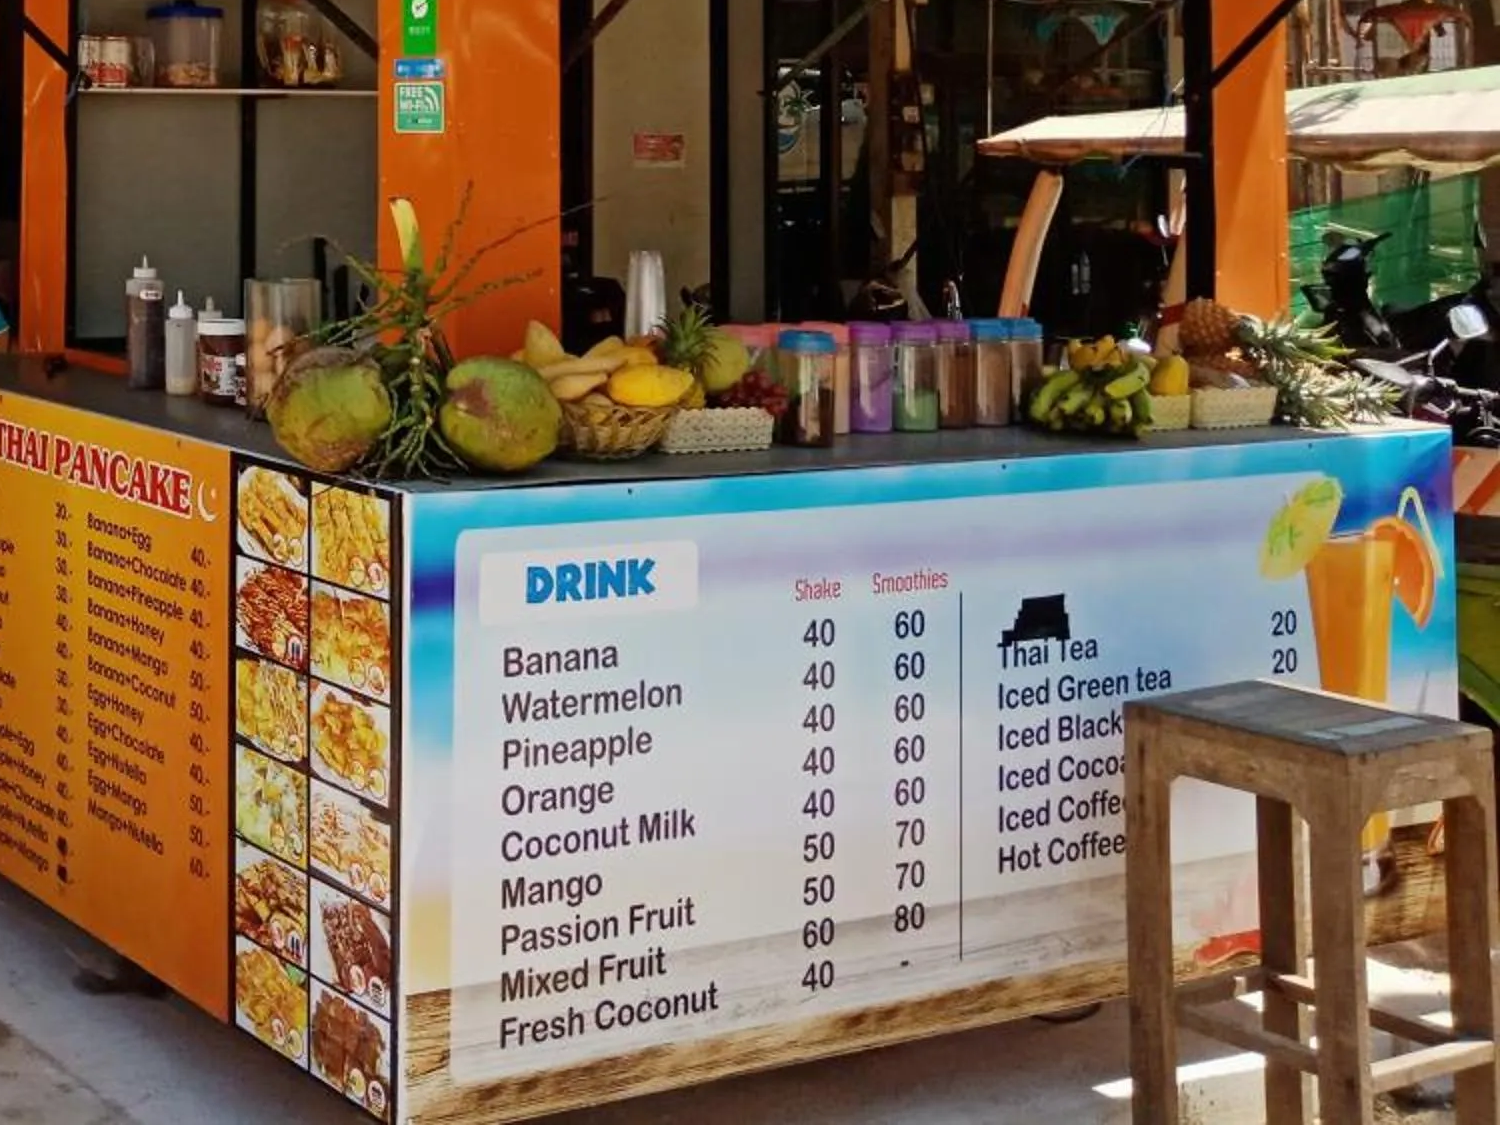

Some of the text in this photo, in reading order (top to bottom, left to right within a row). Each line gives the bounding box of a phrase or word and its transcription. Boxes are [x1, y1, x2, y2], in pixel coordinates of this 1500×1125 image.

[53, 433, 192, 519] PANCAKE
[524, 556, 656, 605] DRINK
[794, 568, 949, 602] Shake Smoothies
[503, 609, 926, 677] Banana 40 60
[1271, 609, 1298, 637] 20
[502, 650, 926, 725] Watermelon 40 60
[998, 648, 1298, 710] Iced Green tea 20
[502, 692, 926, 771] Pineapple 40 60
[998, 709, 1124, 751] Iced Black
[501, 734, 926, 817] Orange 40 60
[998, 758, 1051, 791] Iced
[501, 776, 926, 862] Coconut Milk 40 60
[998, 799, 1051, 833] Iced
[501, 818, 926, 910] Mango 50 70
[998, 831, 1127, 875] Hot Coffee
[500, 859, 926, 956] Passion Fruit 50 70
[500, 902, 926, 1002] Mixed Fruit 60 80
[499, 1005, 585, 1049] Fresh
[594, 981, 719, 1032] Coconut
[801, 959, 836, 991] 40
